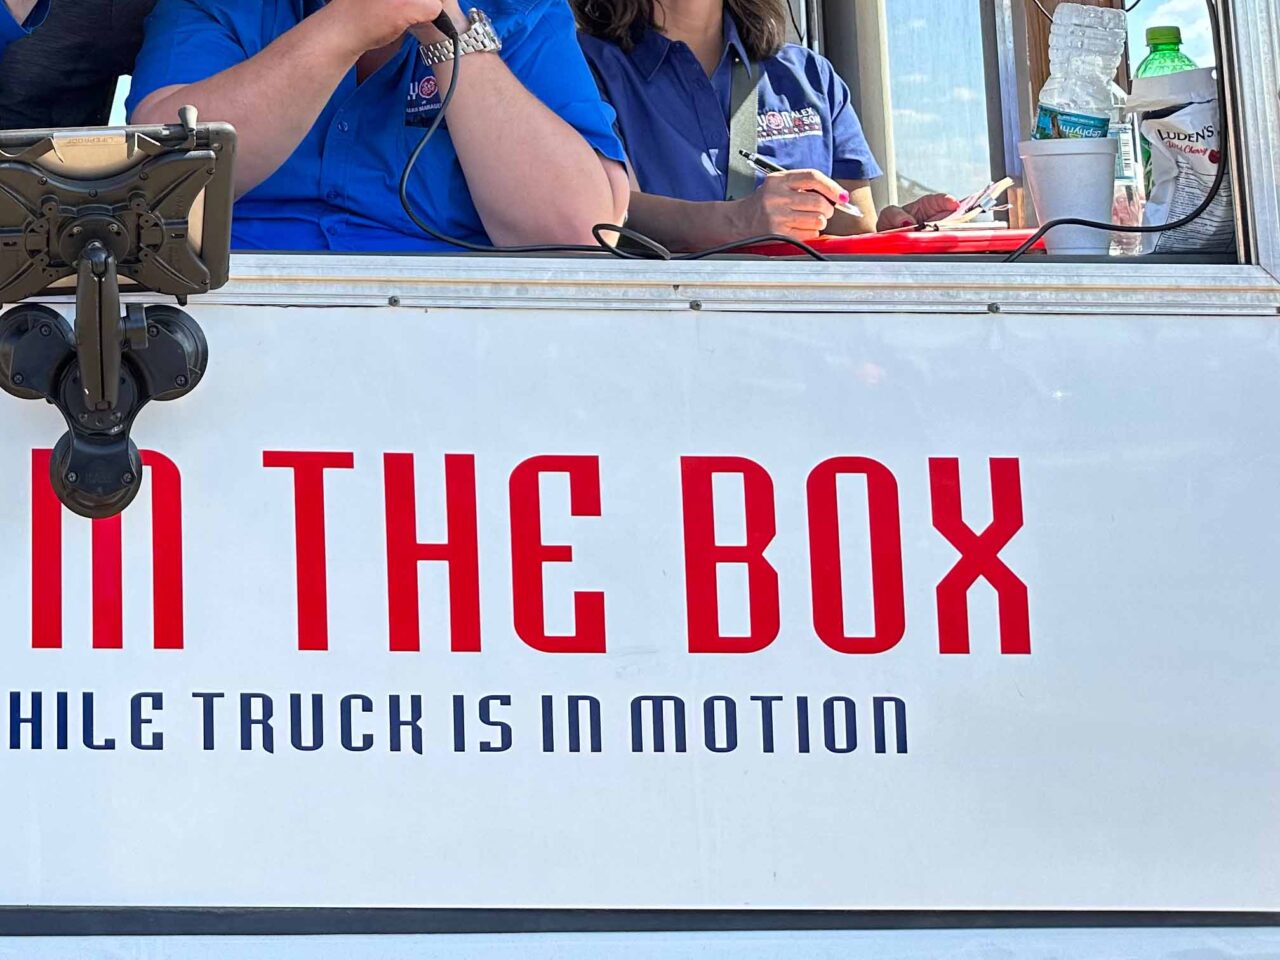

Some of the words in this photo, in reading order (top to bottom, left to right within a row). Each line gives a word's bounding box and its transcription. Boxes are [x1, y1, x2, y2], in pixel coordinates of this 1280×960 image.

[1157, 125, 1215, 143] LUDEN'S
[263, 451, 607, 653] THE
[681, 456, 1032, 654] BOX
[192, 692, 423, 755] TRUCK
[452, 694, 513, 753] IS
[541, 695, 602, 753] IN
[630, 695, 908, 754] MOTION
